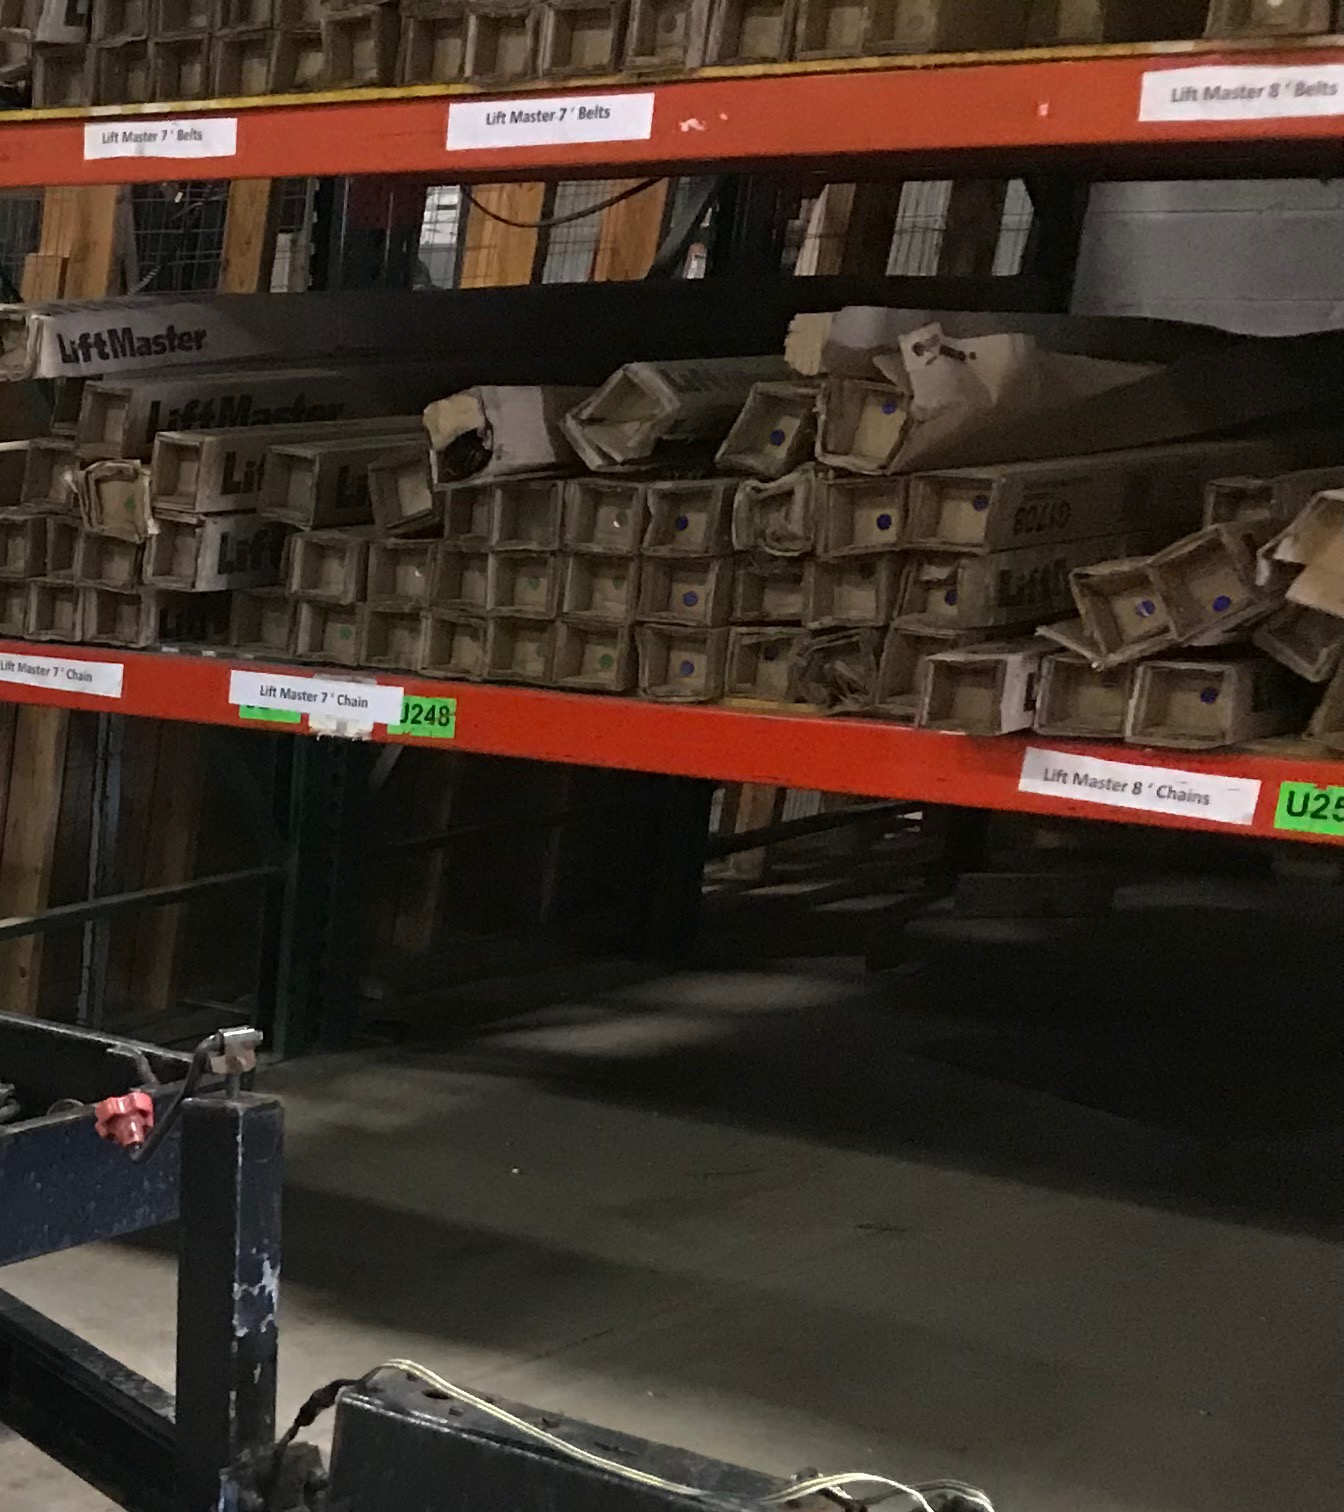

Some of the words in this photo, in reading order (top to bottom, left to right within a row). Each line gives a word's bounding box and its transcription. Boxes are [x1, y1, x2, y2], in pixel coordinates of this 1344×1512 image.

[1171, 86, 1198, 102] Lift
[1203, 84, 1265, 100] Master
[1294, 80, 1338, 97] Belts
[486, 111, 506, 125] Lift
[509, 108, 556, 124] Master
[578, 104, 611, 120] Belts
[102, 131, 119, 144] Lift
[122, 130, 158, 143] Master
[177, 128, 203, 141] Belts
[57, 325, 207, 364] LiftMaster
[0, 659, 15, 672] Lift
[17, 662, 51, 677] Master
[66, 668, 93, 682] Chain
[259, 684, 277, 698] Lift
[279, 686, 317, 703] Master
[337, 694, 369, 709] Chain
[1043, 767, 1068, 785] Lift
[1072, 772, 1128, 793] Master
[1156, 784, 1210, 806] Chains
